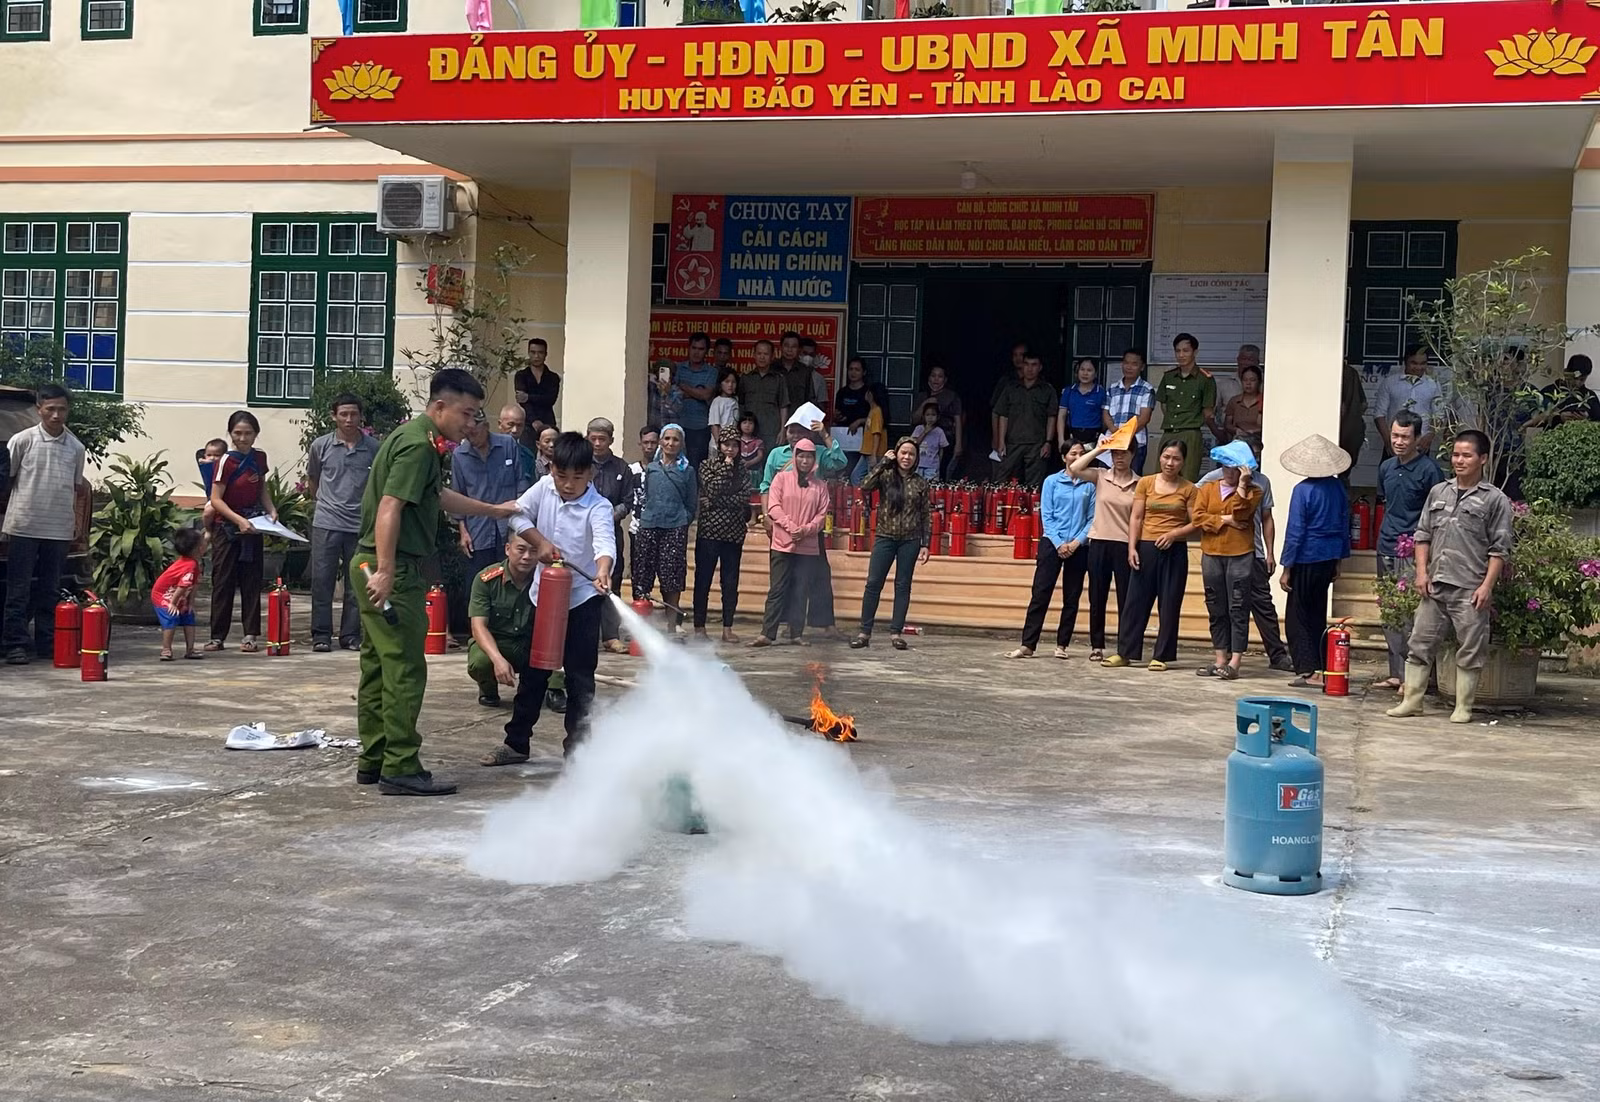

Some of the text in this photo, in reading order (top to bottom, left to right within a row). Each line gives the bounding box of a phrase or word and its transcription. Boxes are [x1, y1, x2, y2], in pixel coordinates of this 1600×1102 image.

[427, 10, 1444, 81] ĐẢNG ỦY - HĐND - UBND XÃ MINH TÂN
[618, 82, 731, 114] HUYỆN
[743, 77, 814, 109] BẢO
[828, 78, 898, 107] YÊN
[932, 73, 1015, 105] TỈNH
[1029, 72, 1102, 104] LÀO
[1119, 77, 1185, 101] CAI
[729, 202, 848, 221] CHUNG TAY
[1042, 201, 1062, 212] MINH
[954, 219, 972, 231] THEO
[1047, 219, 1073, 231] PHONG
[1122, 219, 1143, 230] MINH
[741, 223, 828, 248] CẢI CÁCH
[900, 239, 924, 251] NGHE
[986, 239, 1004, 251] CHO
[1077, 239, 1095, 251] CHO
[729, 250, 843, 271] HÀNH CHÍNH
[737, 276, 832, 297] NHÀ NƯỚC
[662, 319, 684, 335] VIỆC
[686, 321, 709, 333] THEO
[736, 320, 761, 334] PHÁP
[763, 320, 776, 334] VÀ
[806, 321, 831, 339] LUẬT
